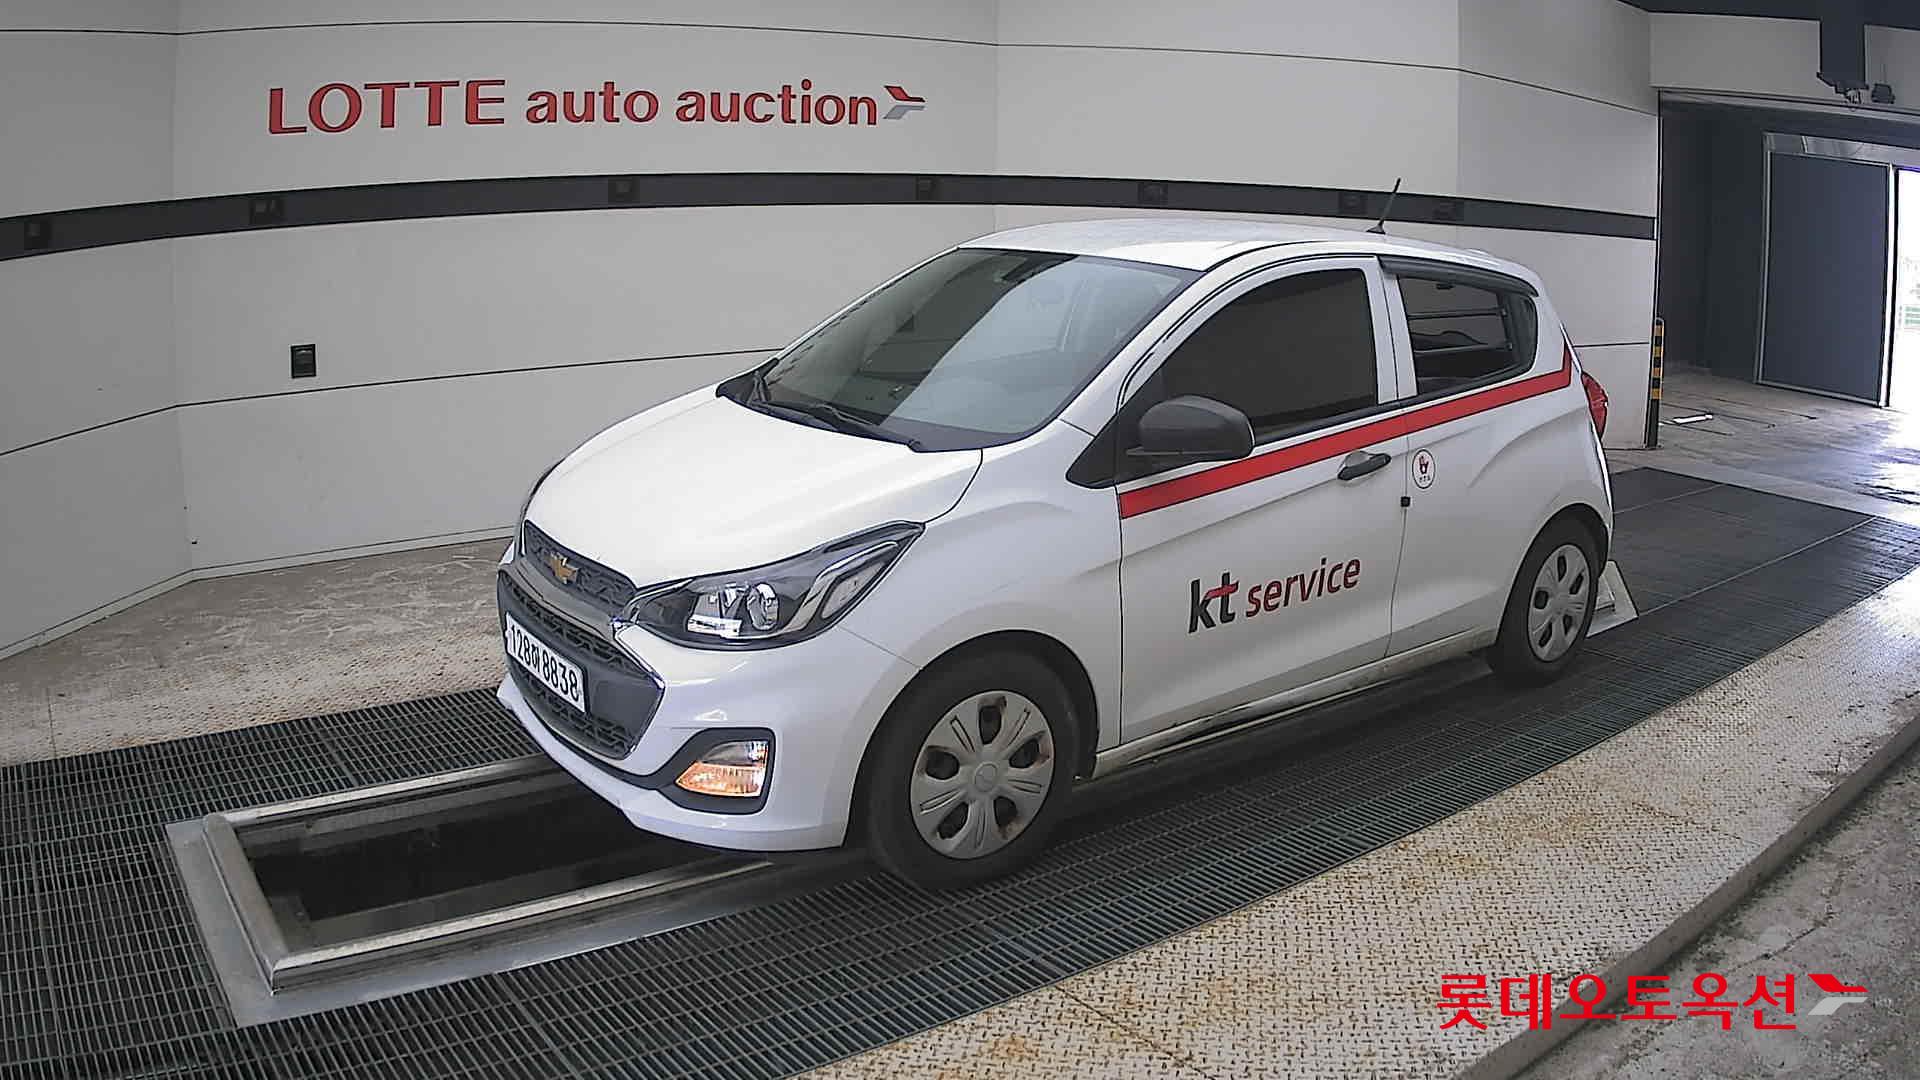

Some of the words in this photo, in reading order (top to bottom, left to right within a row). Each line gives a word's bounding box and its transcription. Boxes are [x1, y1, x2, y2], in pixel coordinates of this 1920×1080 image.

[268, 79, 506, 135] LOTTE
[526, 80, 659, 125] auto
[675, 79, 879, 125] auction
[1188, 571, 1240, 634] kt
[1245, 557, 1361, 618] service
